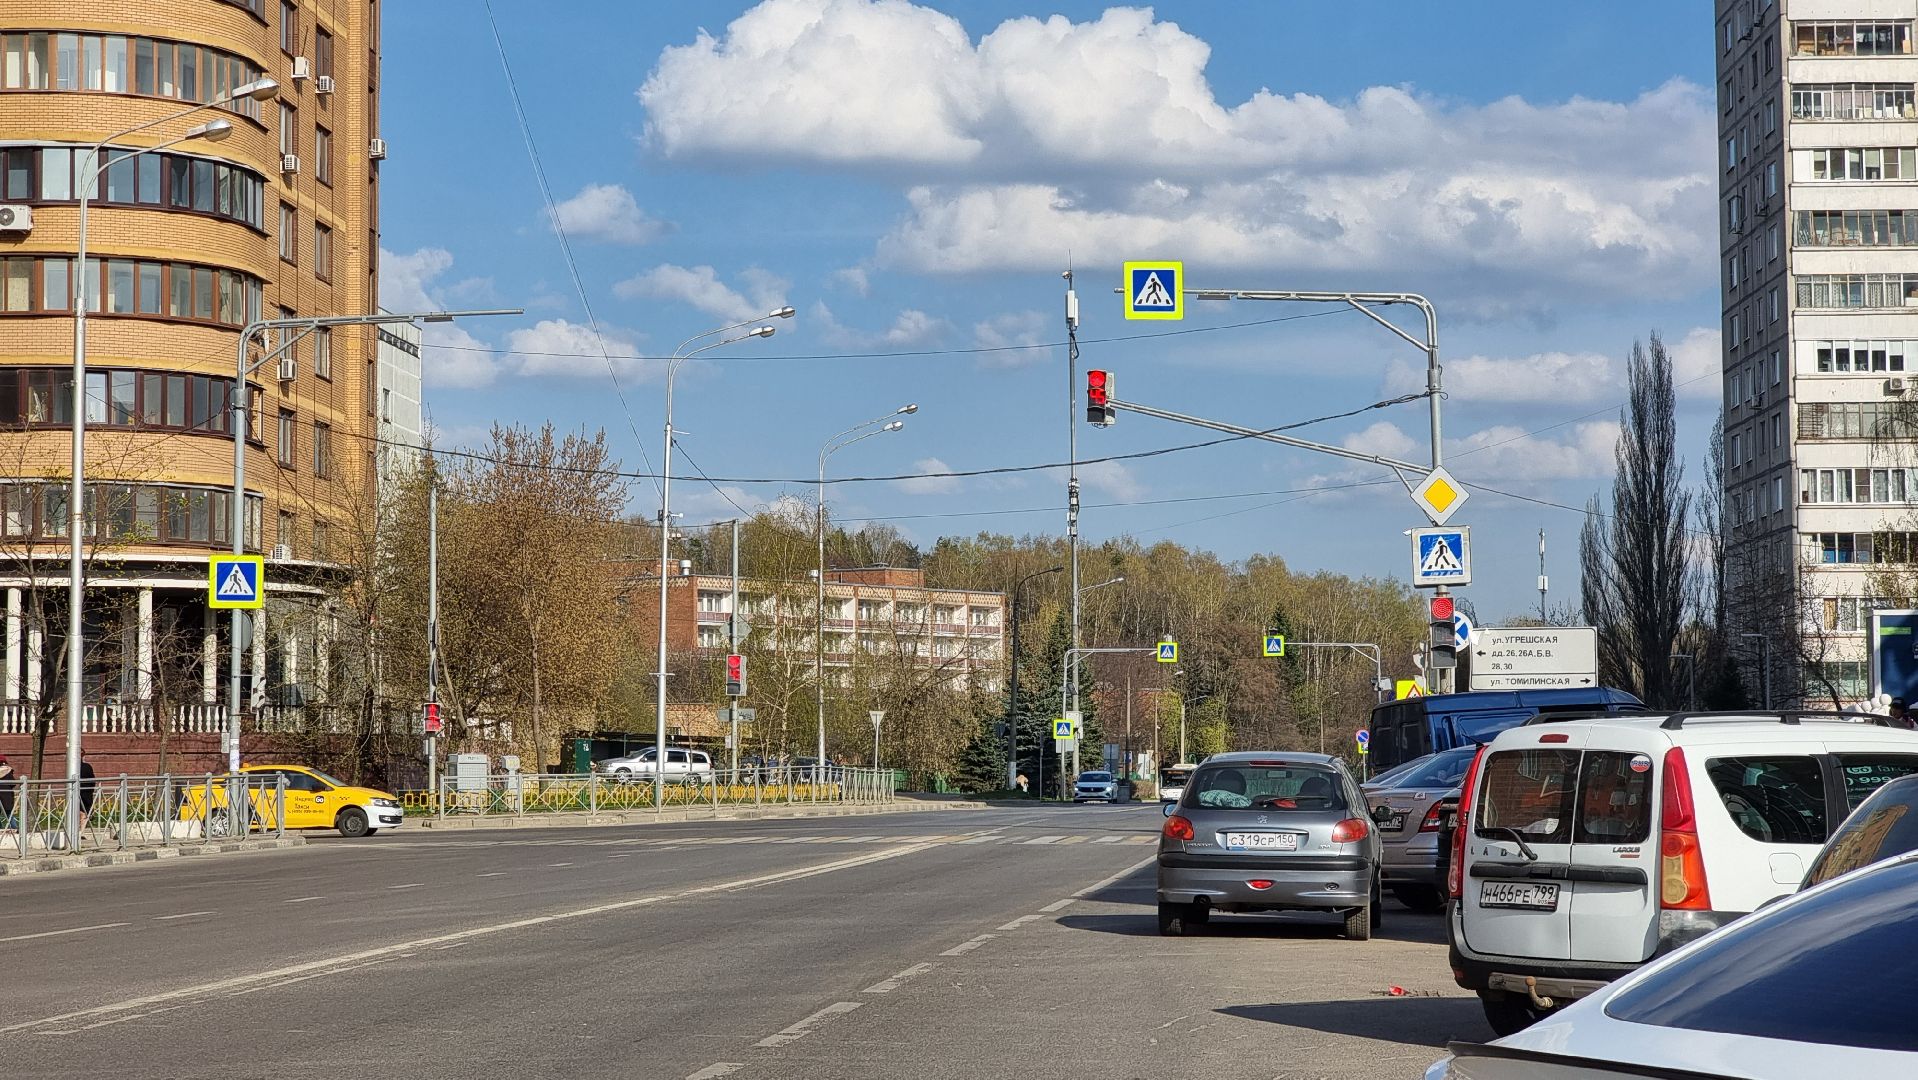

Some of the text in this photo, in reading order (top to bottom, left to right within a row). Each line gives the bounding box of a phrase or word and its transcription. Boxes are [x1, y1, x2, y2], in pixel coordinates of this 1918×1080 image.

[1504, 635, 1558, 644] УГРЕШСКАЯ
[1490, 677, 1570, 687] ул. ТОМИЛИНСКАЯ
[1276, 834, 1294, 844] 150
[1533, 885, 1555, 900] 799
